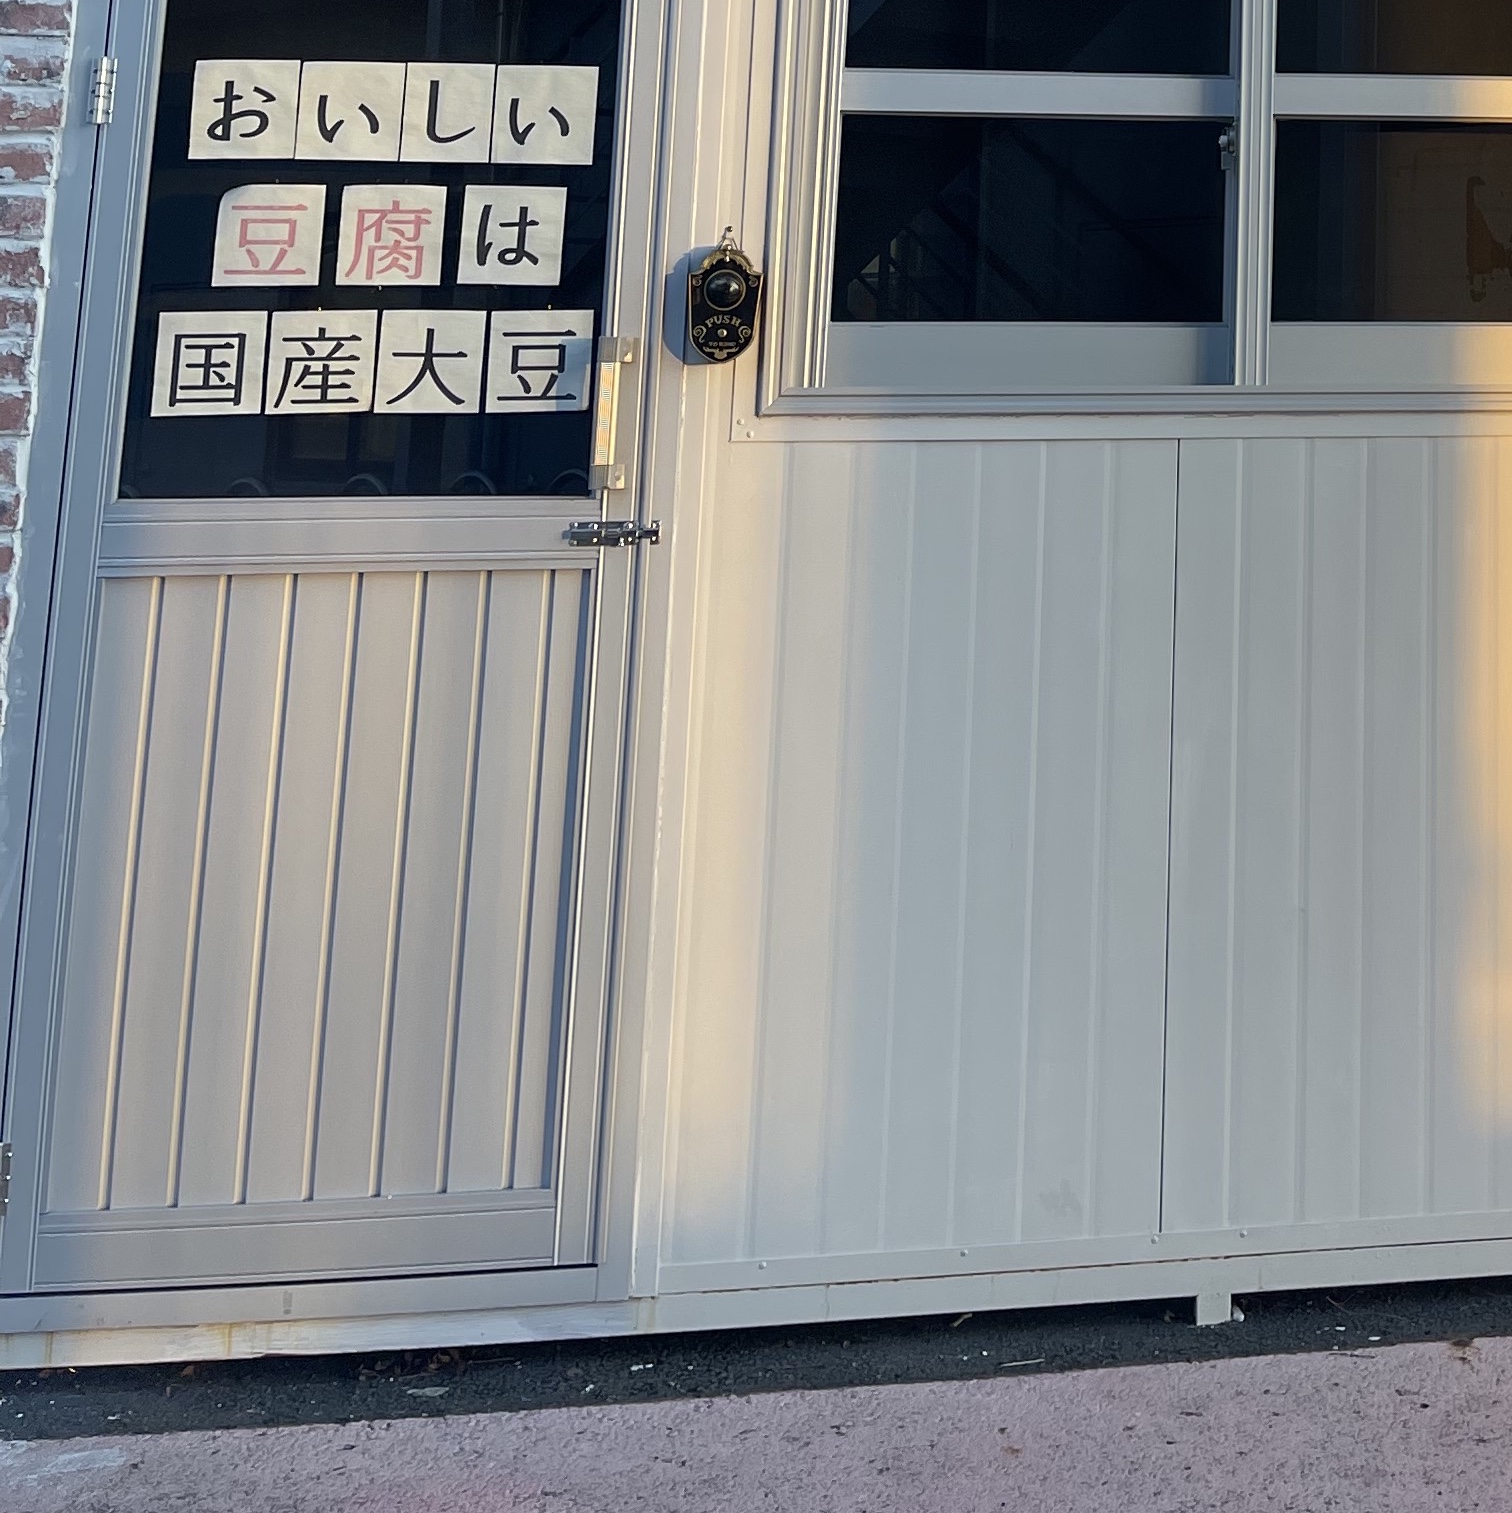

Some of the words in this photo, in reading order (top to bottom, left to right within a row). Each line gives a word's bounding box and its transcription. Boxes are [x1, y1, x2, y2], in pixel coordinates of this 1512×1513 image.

[206, 78, 571, 146] おいしい
[222, 199, 540, 281] 豆腐は
[705, 315, 742, 328] PUSH
[167, 326, 578, 410] 国産大豆
